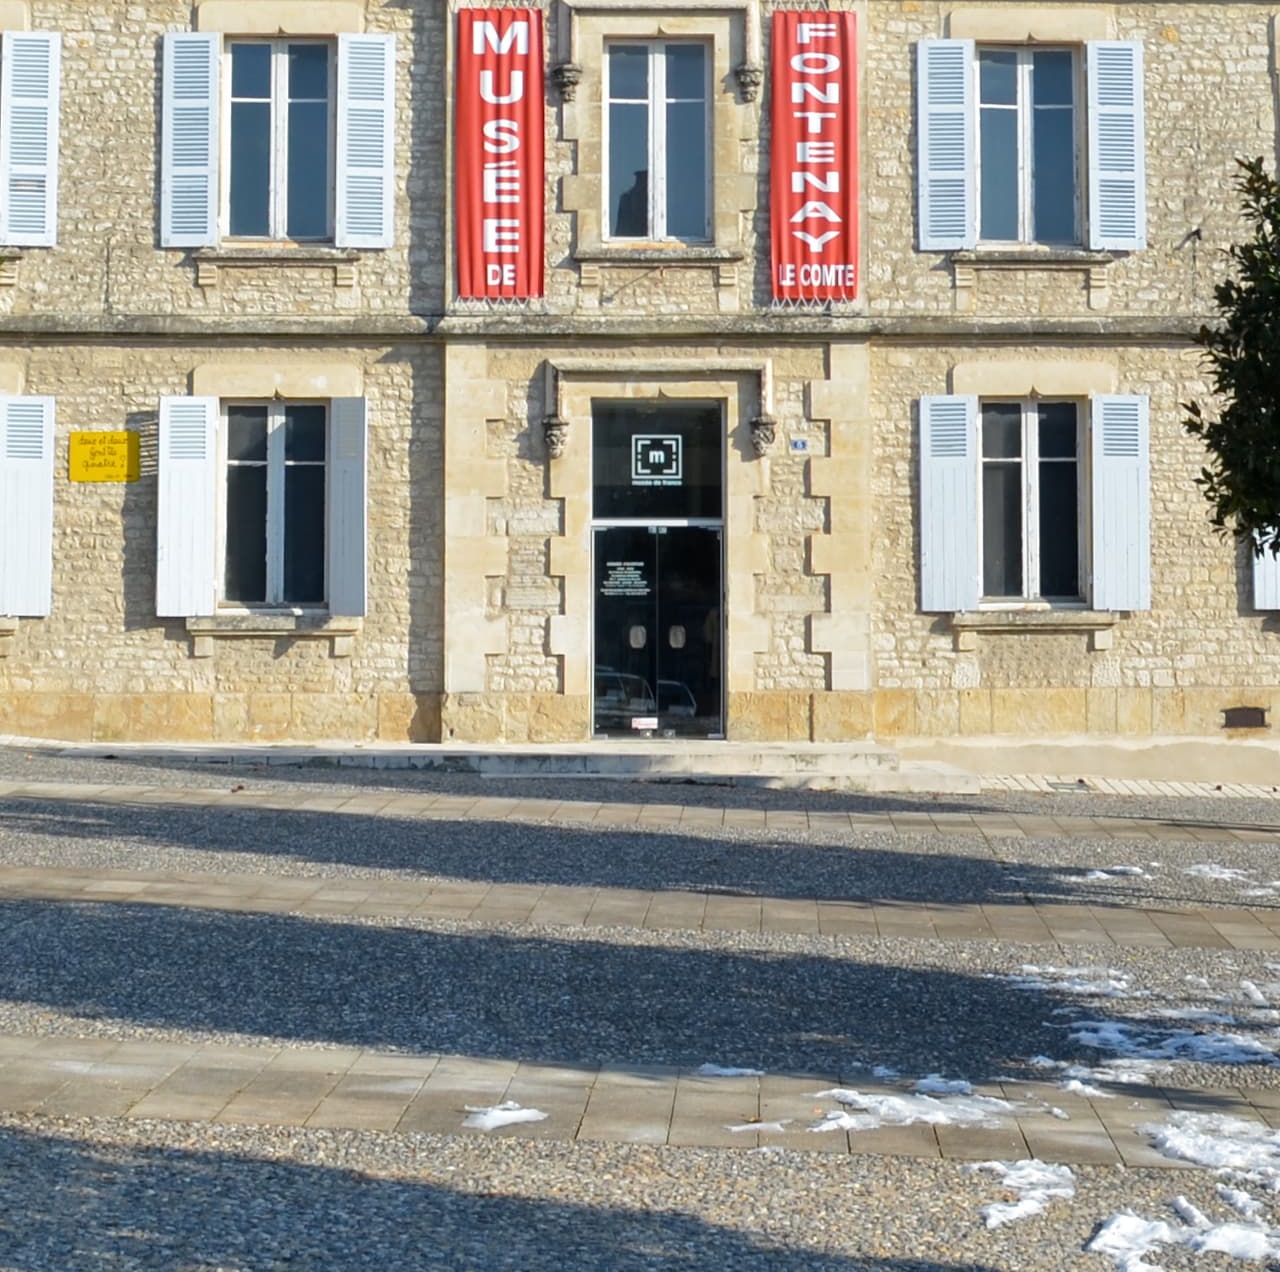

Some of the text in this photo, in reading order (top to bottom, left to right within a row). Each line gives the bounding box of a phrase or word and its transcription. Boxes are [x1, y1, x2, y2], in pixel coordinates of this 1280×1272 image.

[472, 20, 529, 253] MUSÉE
[789, 23, 842, 254] FONTENAY
[486, 264, 516, 286] DE
[779, 264, 855, 287] LE COMTE
[649, 450, 665, 464] m
